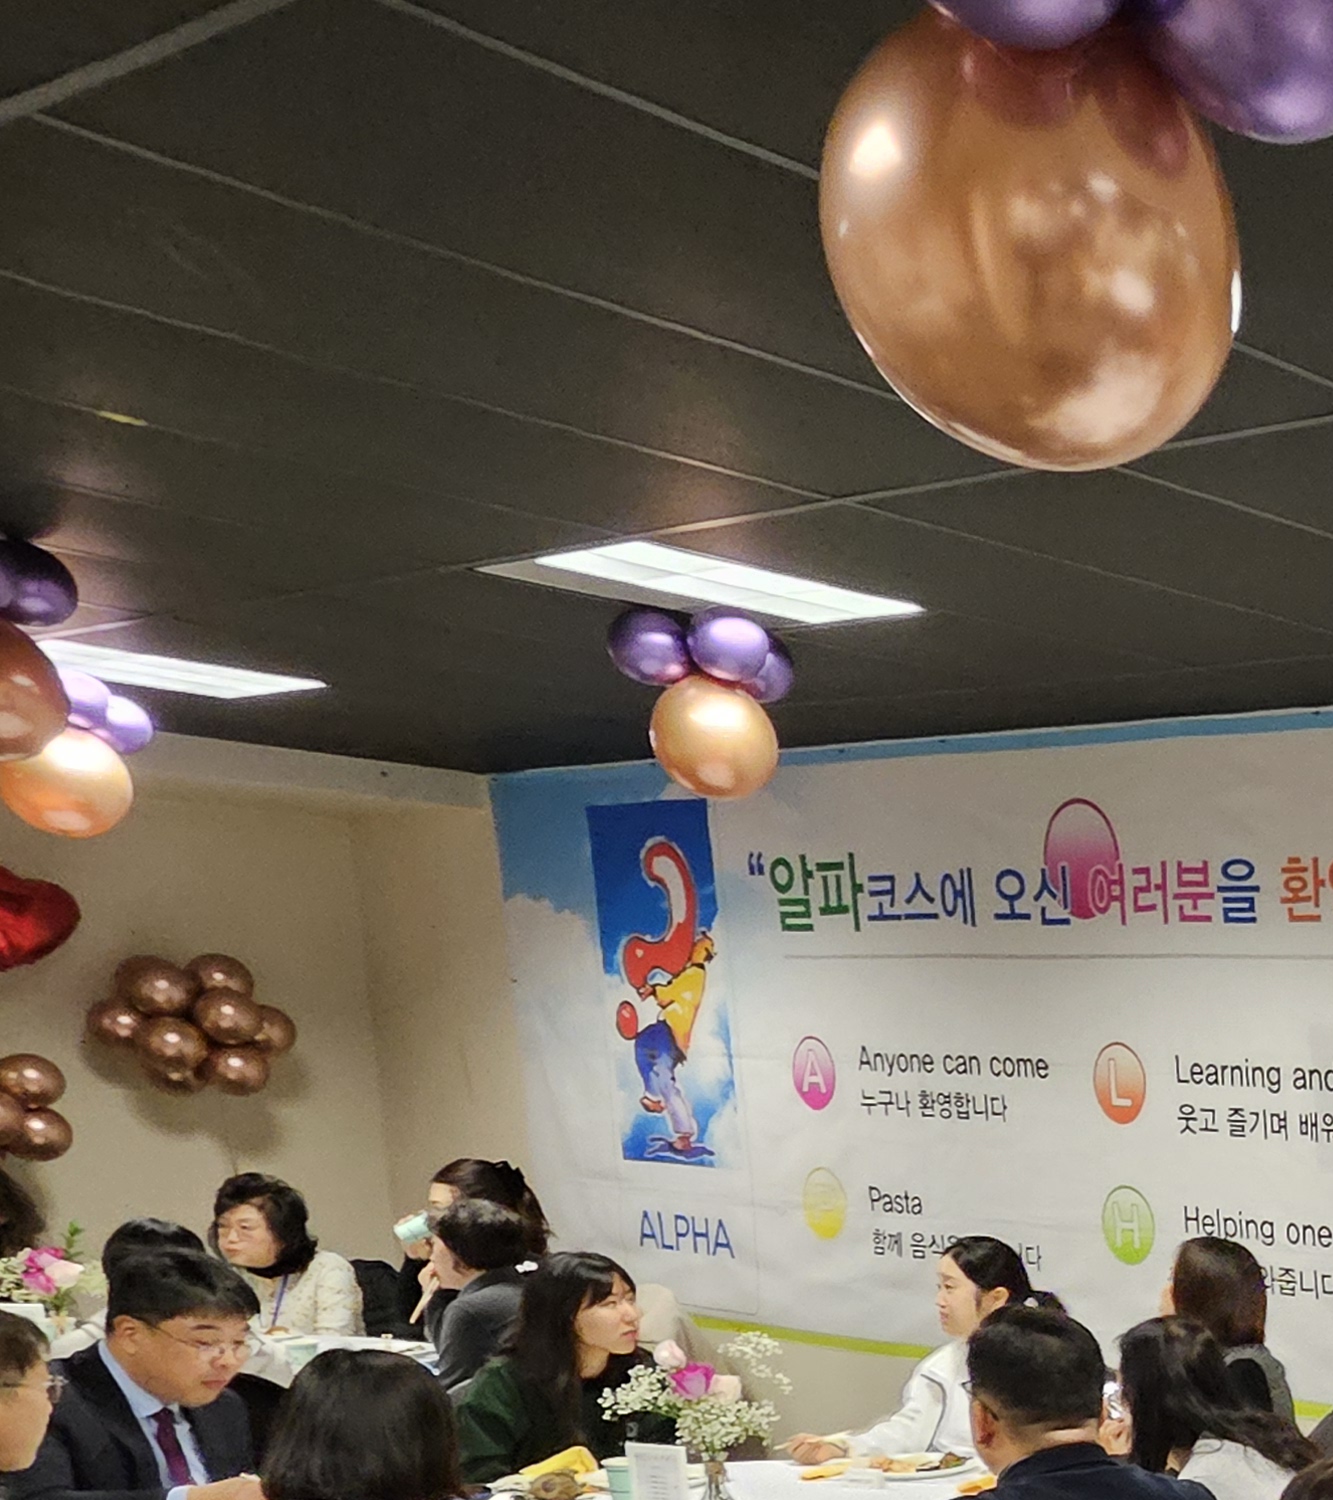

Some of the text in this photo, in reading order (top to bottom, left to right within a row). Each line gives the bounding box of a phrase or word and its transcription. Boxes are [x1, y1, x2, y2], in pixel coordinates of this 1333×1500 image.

[747, 851, 978, 933] “알파코스에
[993, 864, 1072, 926] 오신
[1088, 858, 1261, 927] 여러분을
[802, 1049, 827, 1094] A
[858, 1045, 1049, 1079] Anyone can come
[1107, 1057, 1133, 1108] L
[1175, 1055, 1281, 1094] Learning
[860, 1088, 1009, 1123] 누구나 환영합니다
[1176, 1103, 1220, 1136] 웃고
[1226, 1107, 1289, 1142] 즐기며
[867, 1185, 924, 1216] Pasta
[638, 1209, 736, 1260] ALPHA
[872, 1229, 903, 1258] 함께
[1111, 1201, 1141, 1250] H
[1183, 1205, 1275, 1247] Helping
[1285, 1220, 1333, 1249] one
